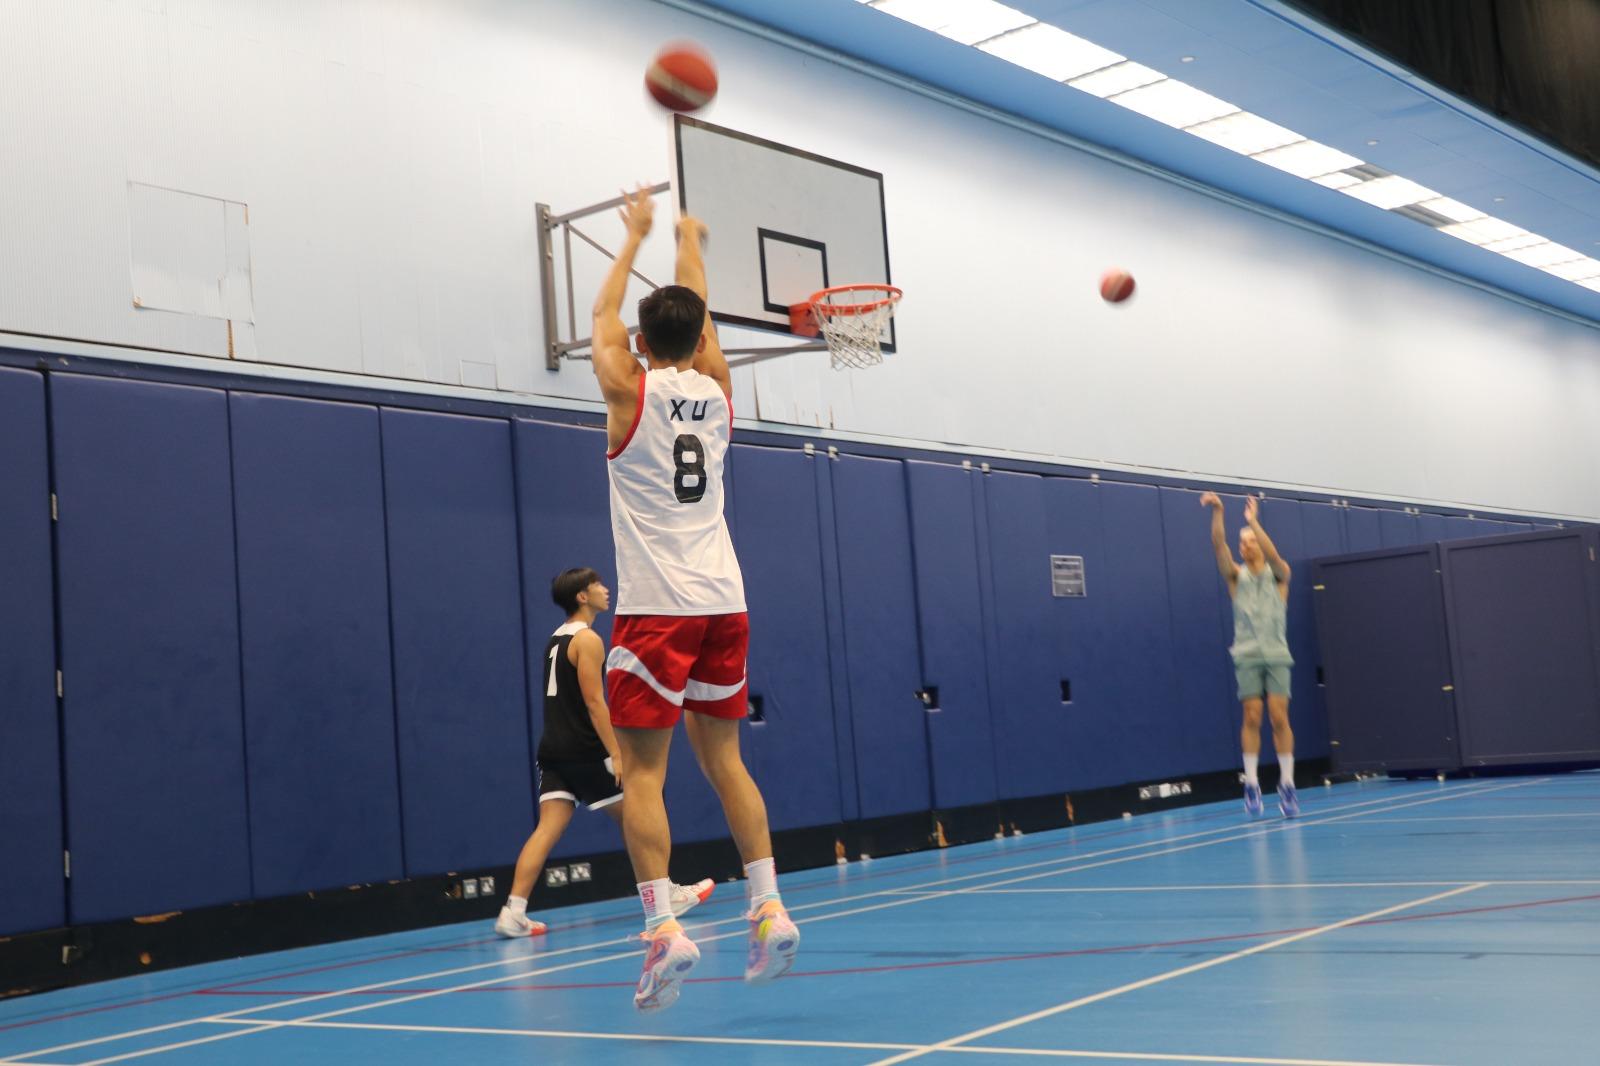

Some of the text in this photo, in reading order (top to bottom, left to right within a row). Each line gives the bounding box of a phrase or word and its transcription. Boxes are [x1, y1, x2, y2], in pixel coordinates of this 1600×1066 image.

[670, 399, 708, 422] XU
[673, 434, 706, 503] 8
[547, 643, 560, 697] 1
